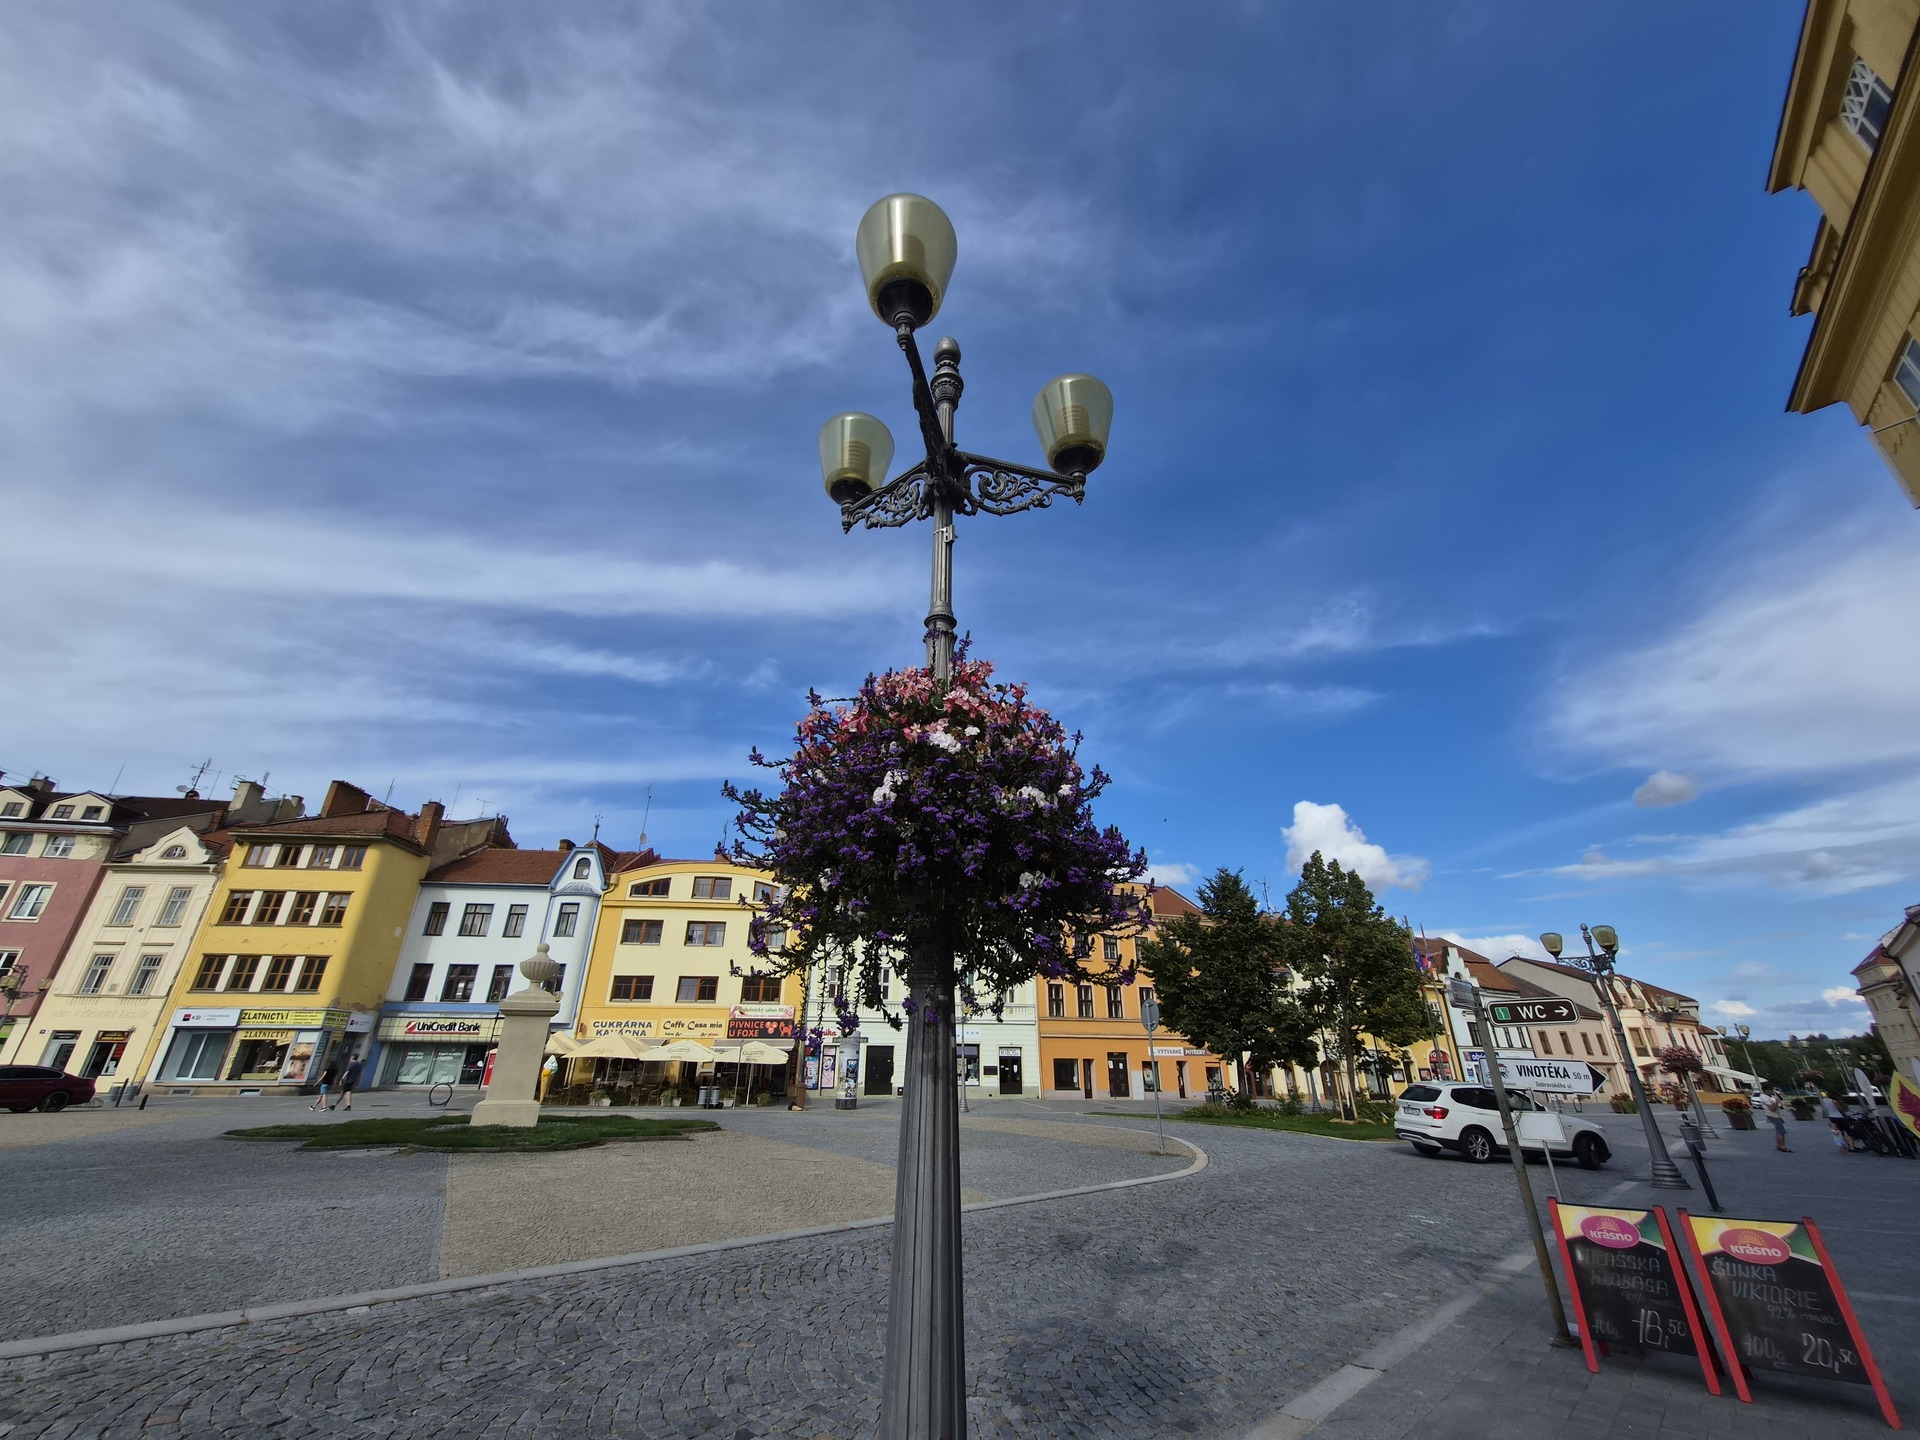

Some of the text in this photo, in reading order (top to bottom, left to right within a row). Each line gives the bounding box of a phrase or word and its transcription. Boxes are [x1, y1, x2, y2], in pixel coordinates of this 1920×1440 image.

[242, 1011, 289, 1020] ZLATNICTVÍ
[1516, 1004, 1547, 1020] WC
[416, 1021, 481, 1032] UniCredit Bank
[592, 1020, 653, 1028] CUKRÁRNA
[663, 1020, 685, 1030] Caffe
[687, 1020, 707, 1030] Casa
[730, 1021, 765, 1029] PIVNICE
[243, 1030, 289, 1038] ZLATNICTVÍ
[729, 1029, 759, 1037] U FOXE
[1515, 1062, 1571, 1079] VINOTÉKA
[1572, 1072, 1582, 1080] 50
[1535, 1081, 1566, 1089] Dobrovského
[1590, 1230, 1633, 1242] Krásno
[1730, 1243, 1782, 1257] Krásno
[1711, 1256, 1776, 1282] ŠUNKA
[1591, 1271, 1669, 1297] KLOBÁSA
[1732, 1280, 1822, 1311] VIKTORIE
[1742, 1332, 1793, 1368] 100g
